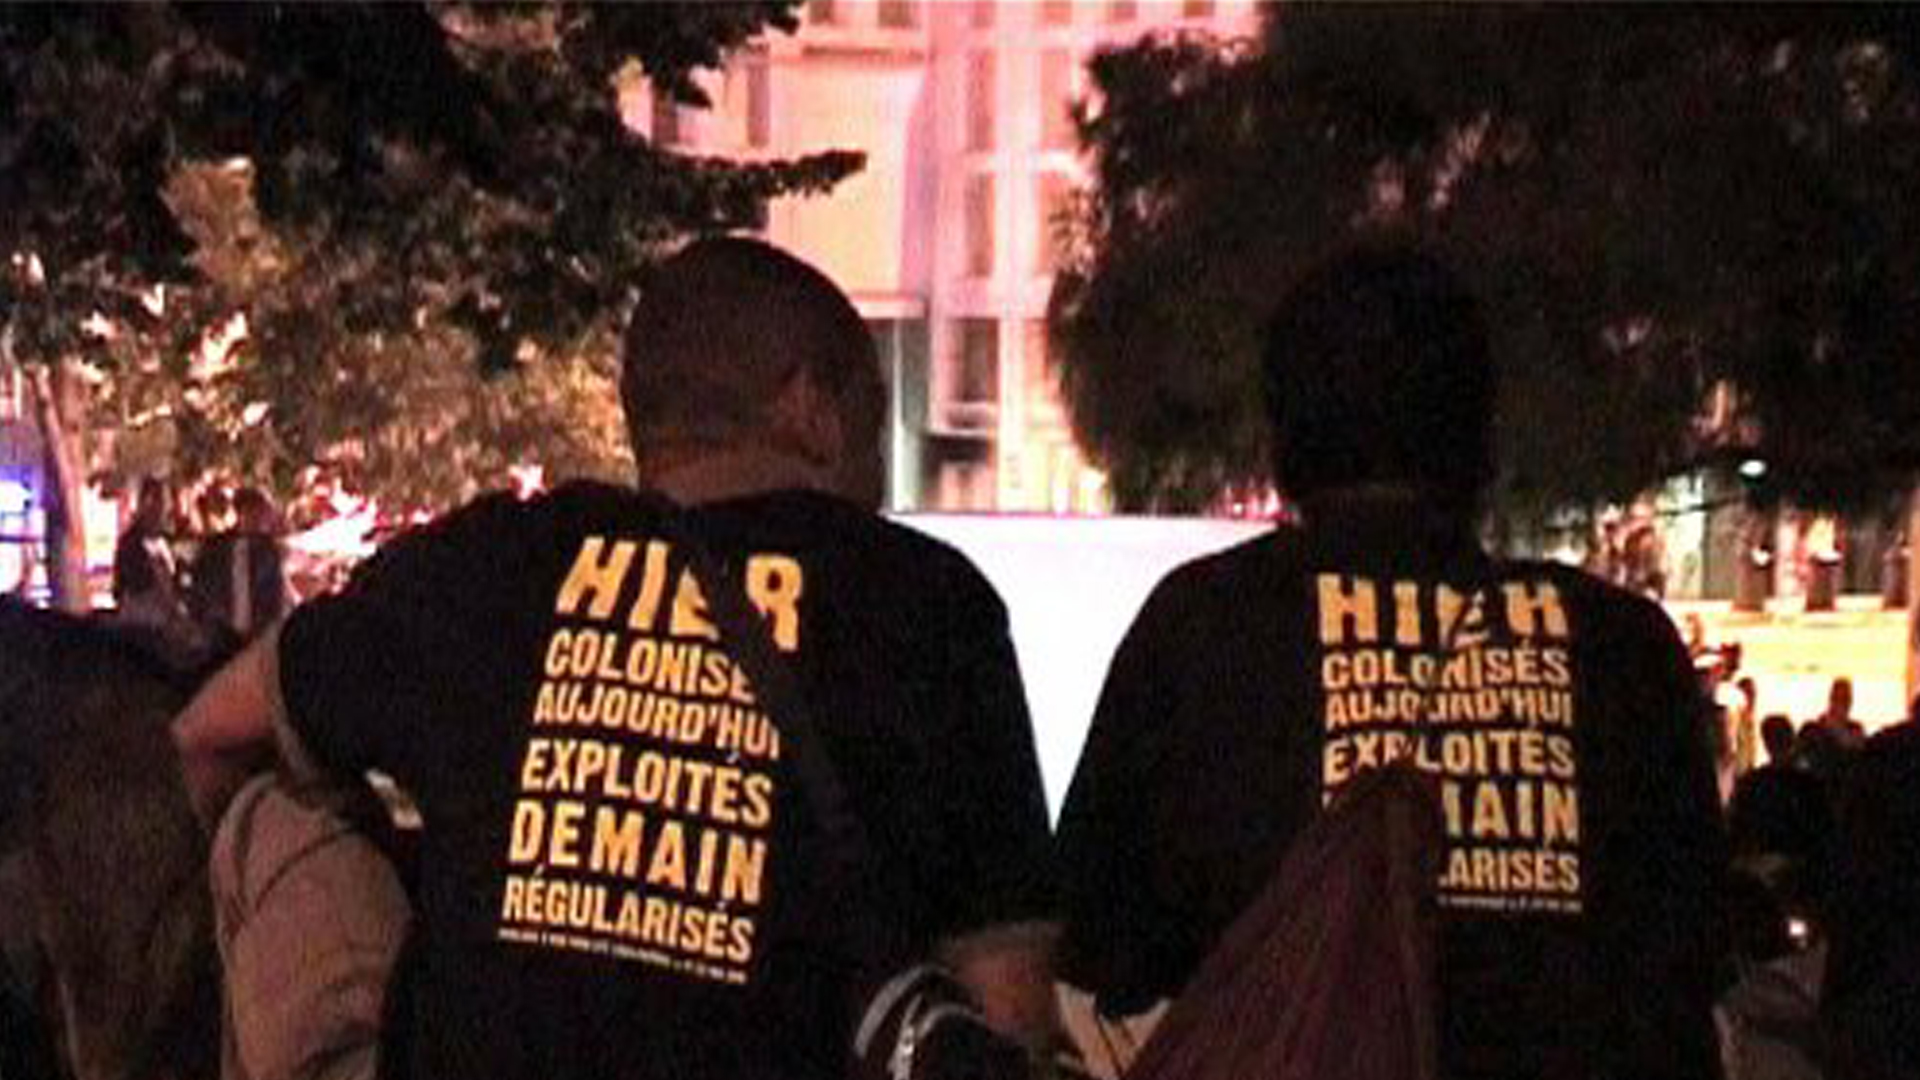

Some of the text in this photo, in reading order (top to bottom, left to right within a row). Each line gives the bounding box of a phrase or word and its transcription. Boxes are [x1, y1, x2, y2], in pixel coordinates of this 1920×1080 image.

[533, 682, 779, 760] AUJOURD'HUI
[521, 738, 773, 828] EXPLOITÉS
[508, 799, 767, 904] DEMAIN
[502, 864, 754, 964] RÉGULARISÉS
